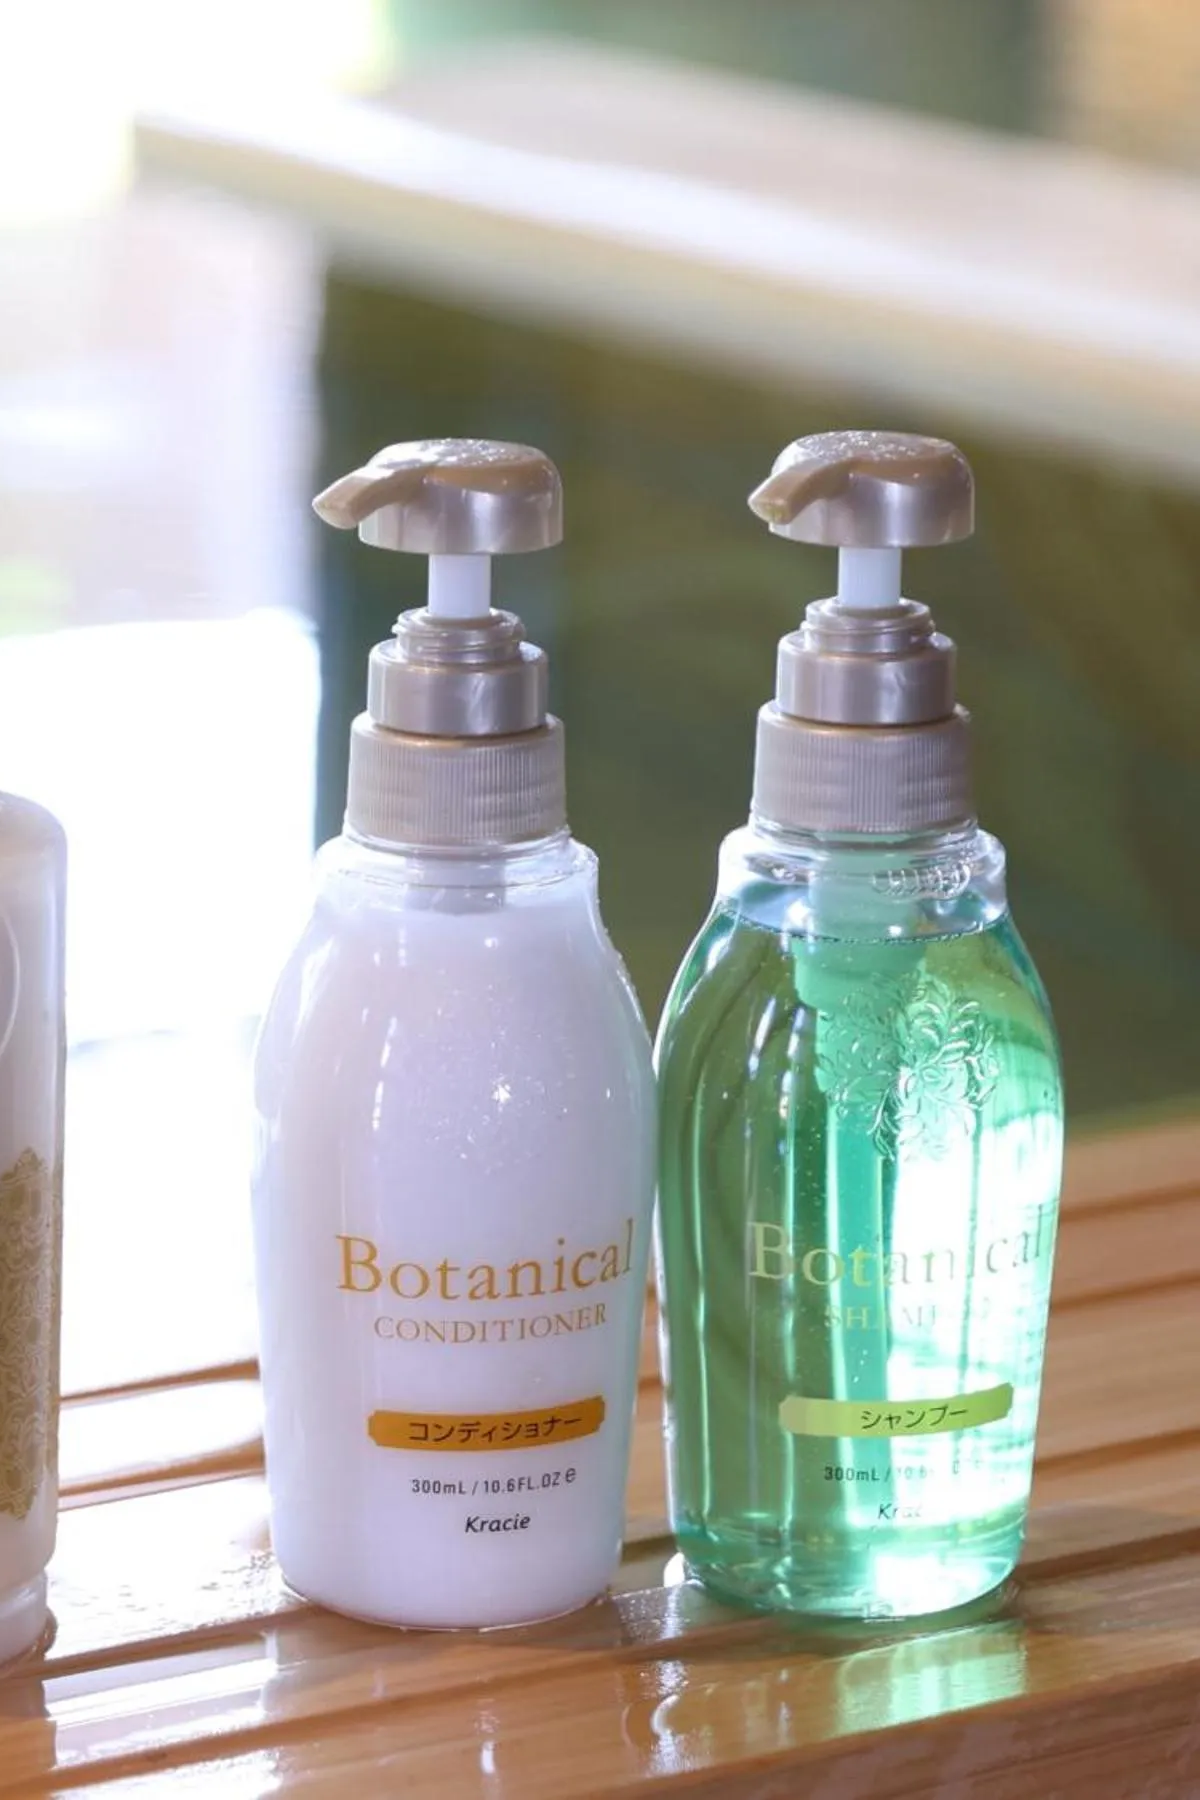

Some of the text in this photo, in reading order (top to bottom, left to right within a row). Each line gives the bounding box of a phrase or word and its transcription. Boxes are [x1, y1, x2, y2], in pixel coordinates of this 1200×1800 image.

[334, 1217, 633, 1301] Botanical
[373, 1302, 607, 1344] CONDITIONER
[409, 1415, 583, 1444] コンディショナー
[824, 1466, 882, 1482] 300mL
[412, 1479, 467, 1496] 300mL
[877, 1503, 930, 1520] Krac
[464, 1513, 532, 1534] Kracie
